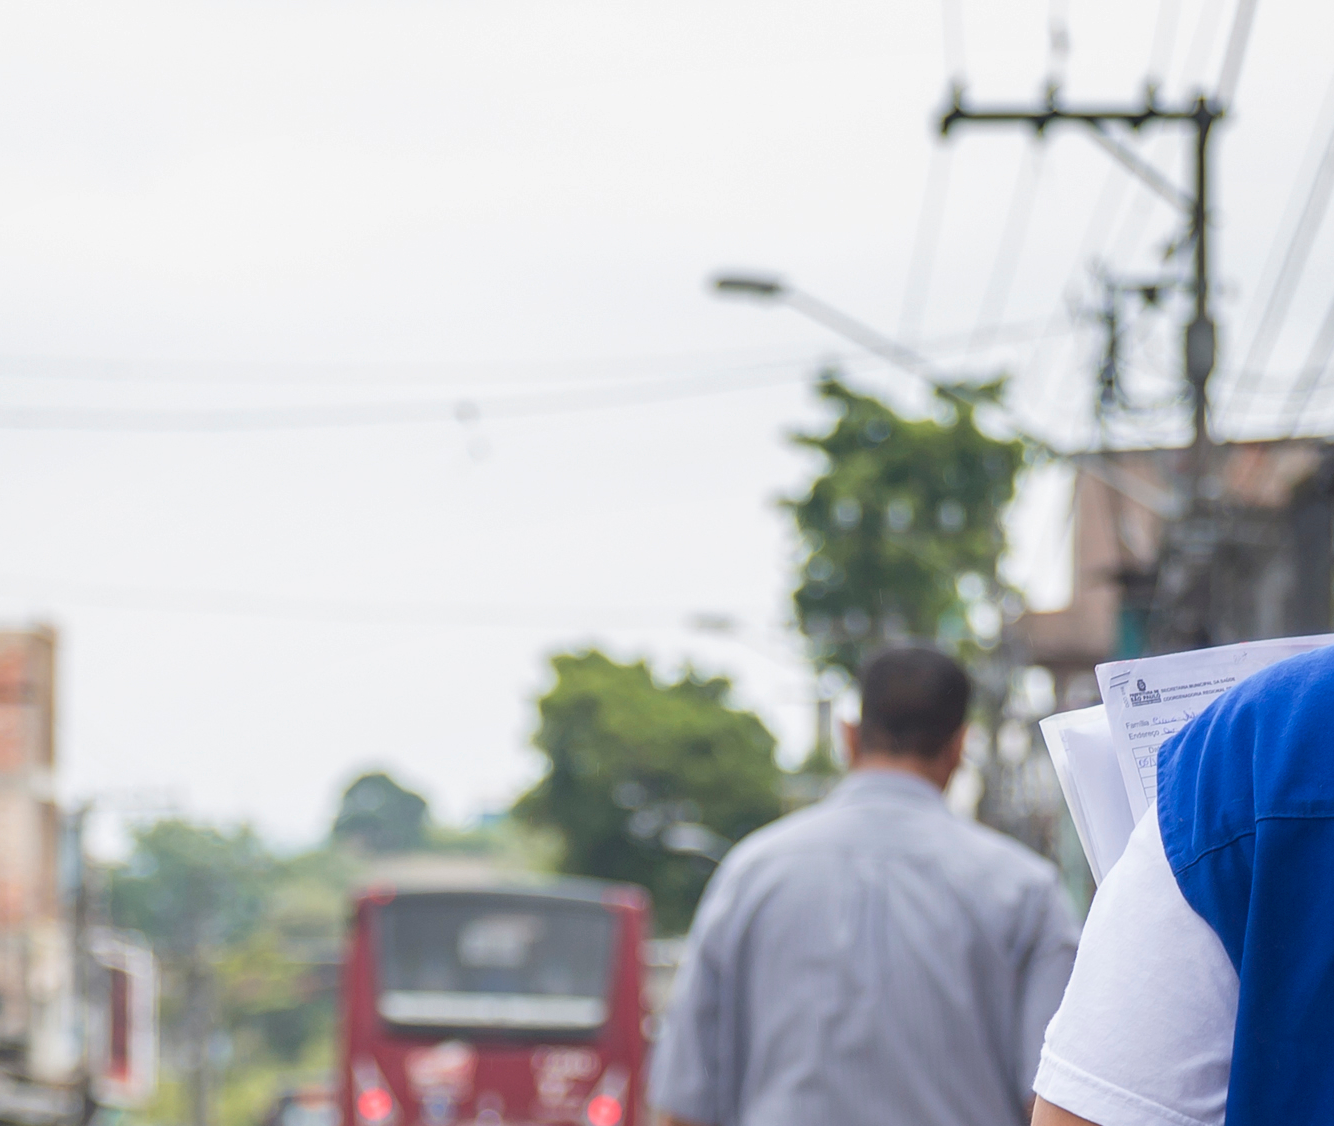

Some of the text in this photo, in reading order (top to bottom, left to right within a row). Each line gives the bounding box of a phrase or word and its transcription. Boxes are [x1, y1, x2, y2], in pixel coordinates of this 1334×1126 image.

[1160, 685, 1188, 693] SECRETARIA
[1125, 720, 1150, 730] Família
[1128, 730, 1160, 740] Endereço
